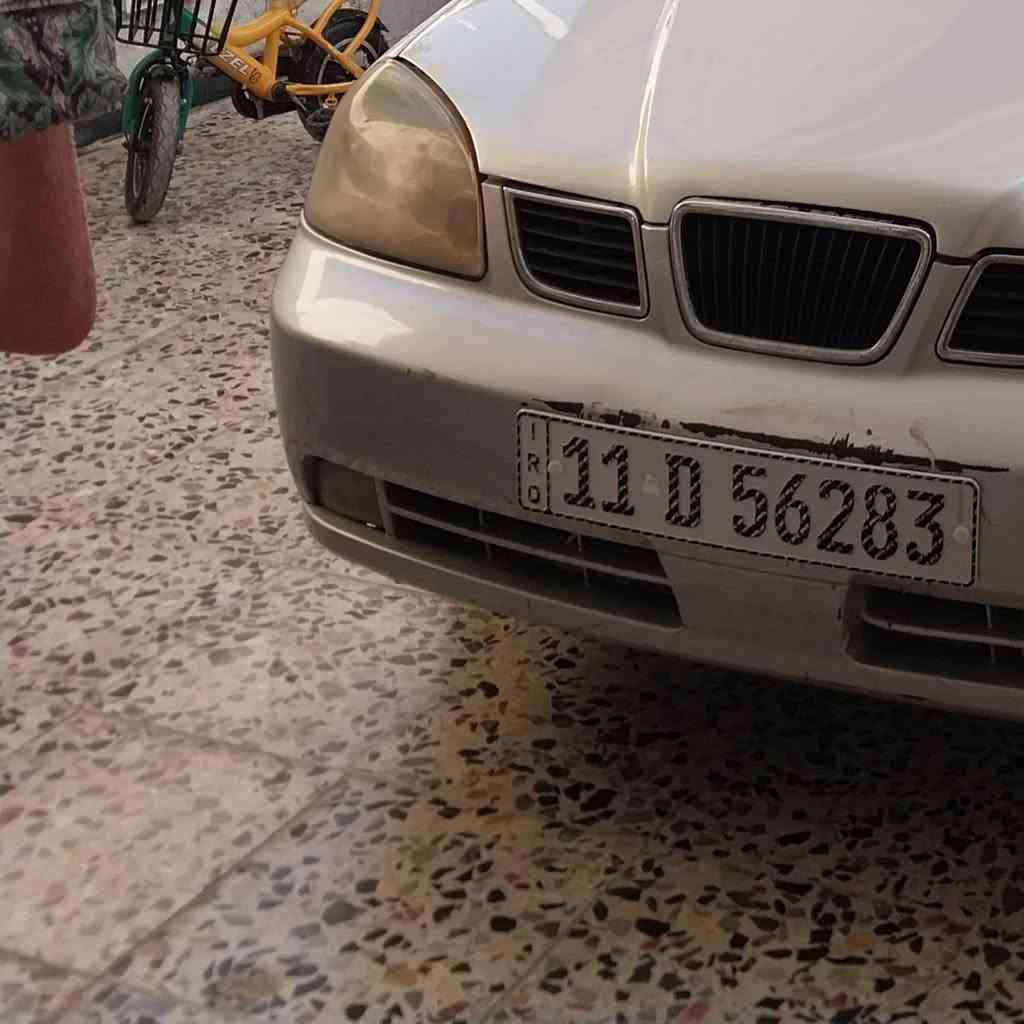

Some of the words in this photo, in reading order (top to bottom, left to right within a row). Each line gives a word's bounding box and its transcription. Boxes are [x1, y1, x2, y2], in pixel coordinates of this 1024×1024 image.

[562, 436, 635, 516] 11
[665, 451, 702, 528] D
[731, 463, 945, 565] 56283
